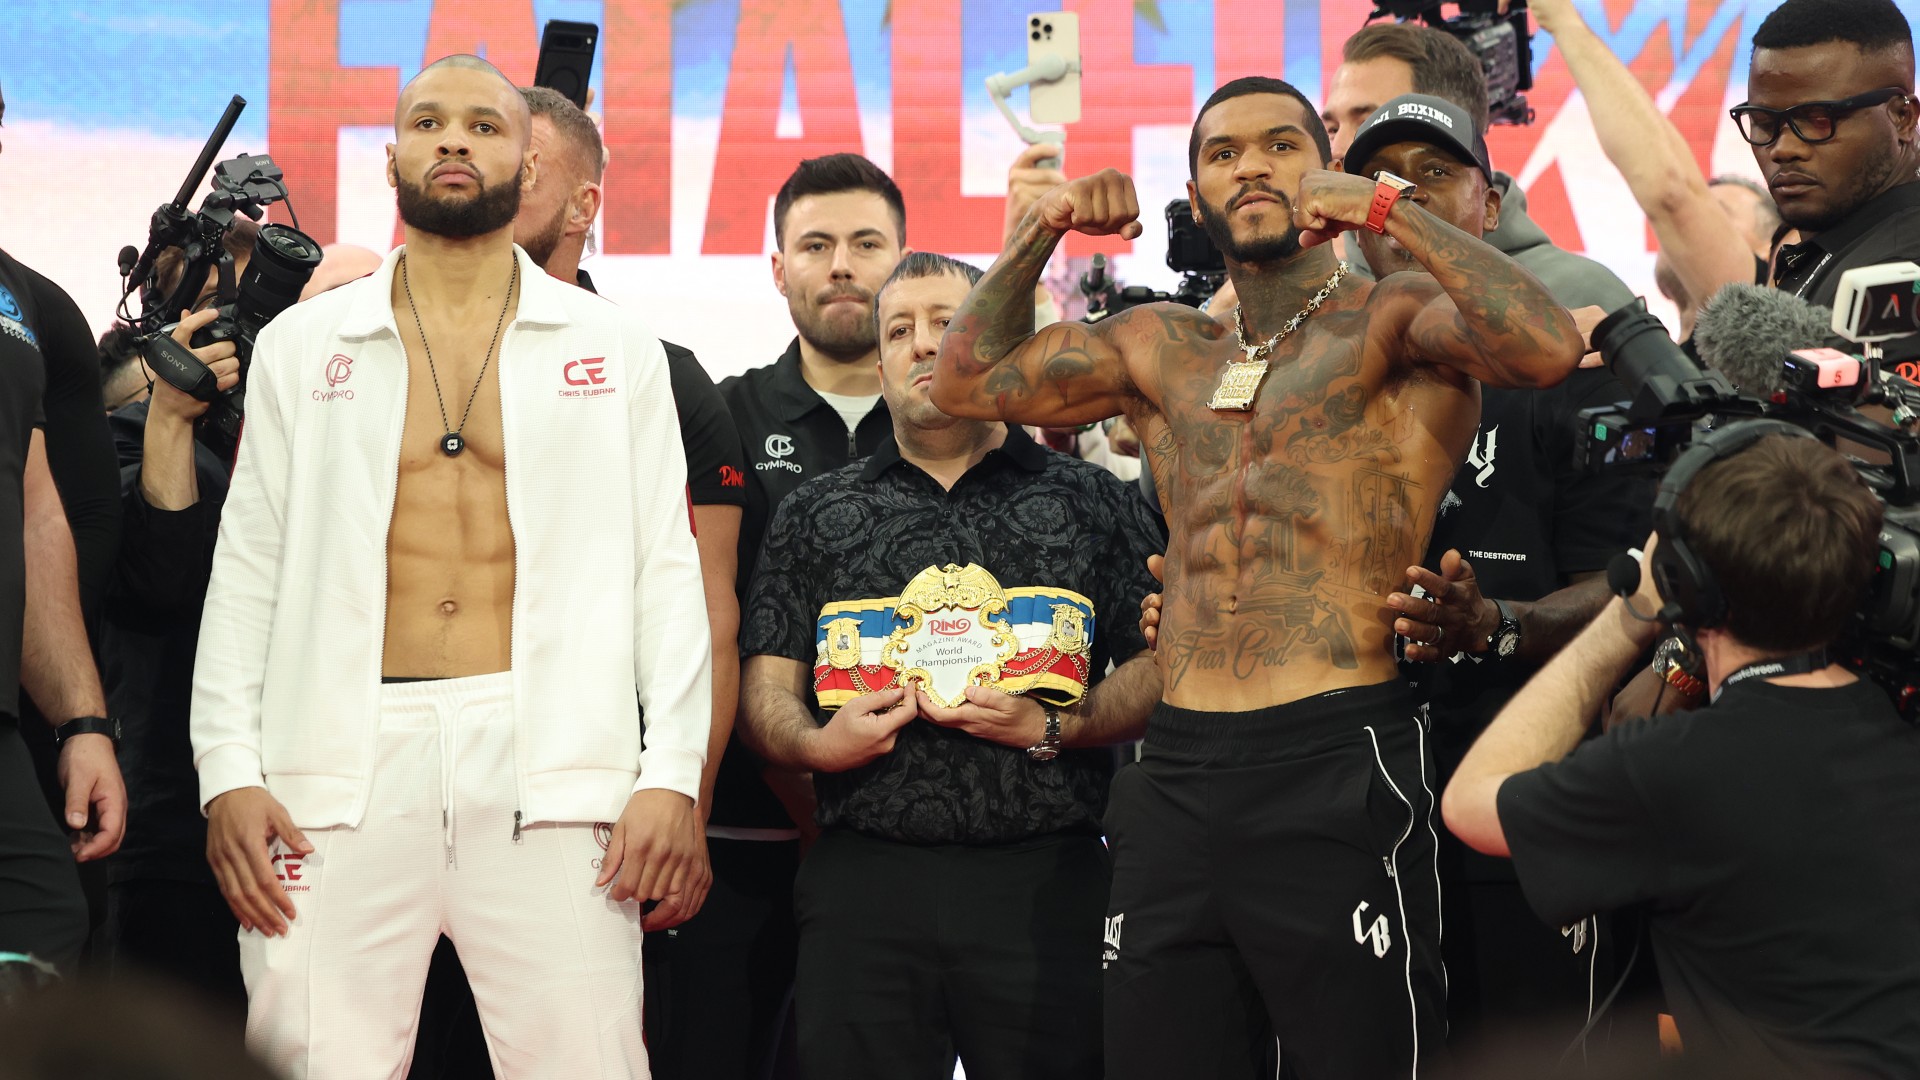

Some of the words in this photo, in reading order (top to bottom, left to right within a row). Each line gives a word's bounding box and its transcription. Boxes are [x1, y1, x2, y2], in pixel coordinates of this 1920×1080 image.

[1397, 103, 1453, 129] BOXING
[160, 350, 188, 372] SONY
[1834, 371, 1843, 384] 5
[312, 389, 354, 402] GYMPRO
[583, 387, 616, 396] EUBANK
[755, 460, 803, 474] GYMPRO
[719, 465, 745, 487] RIN
[1468, 550, 1483, 558] THE
[1483, 551, 1527, 561] DESTROYER
[916, 636, 955, 654] MAGAZINE
[957, 636, 983, 649] AWARD
[935, 646, 963, 656] World
[1232, 620, 1303, 680] God
[915, 655, 983, 667] Championship
[1103, 912, 1125, 951] LAST
